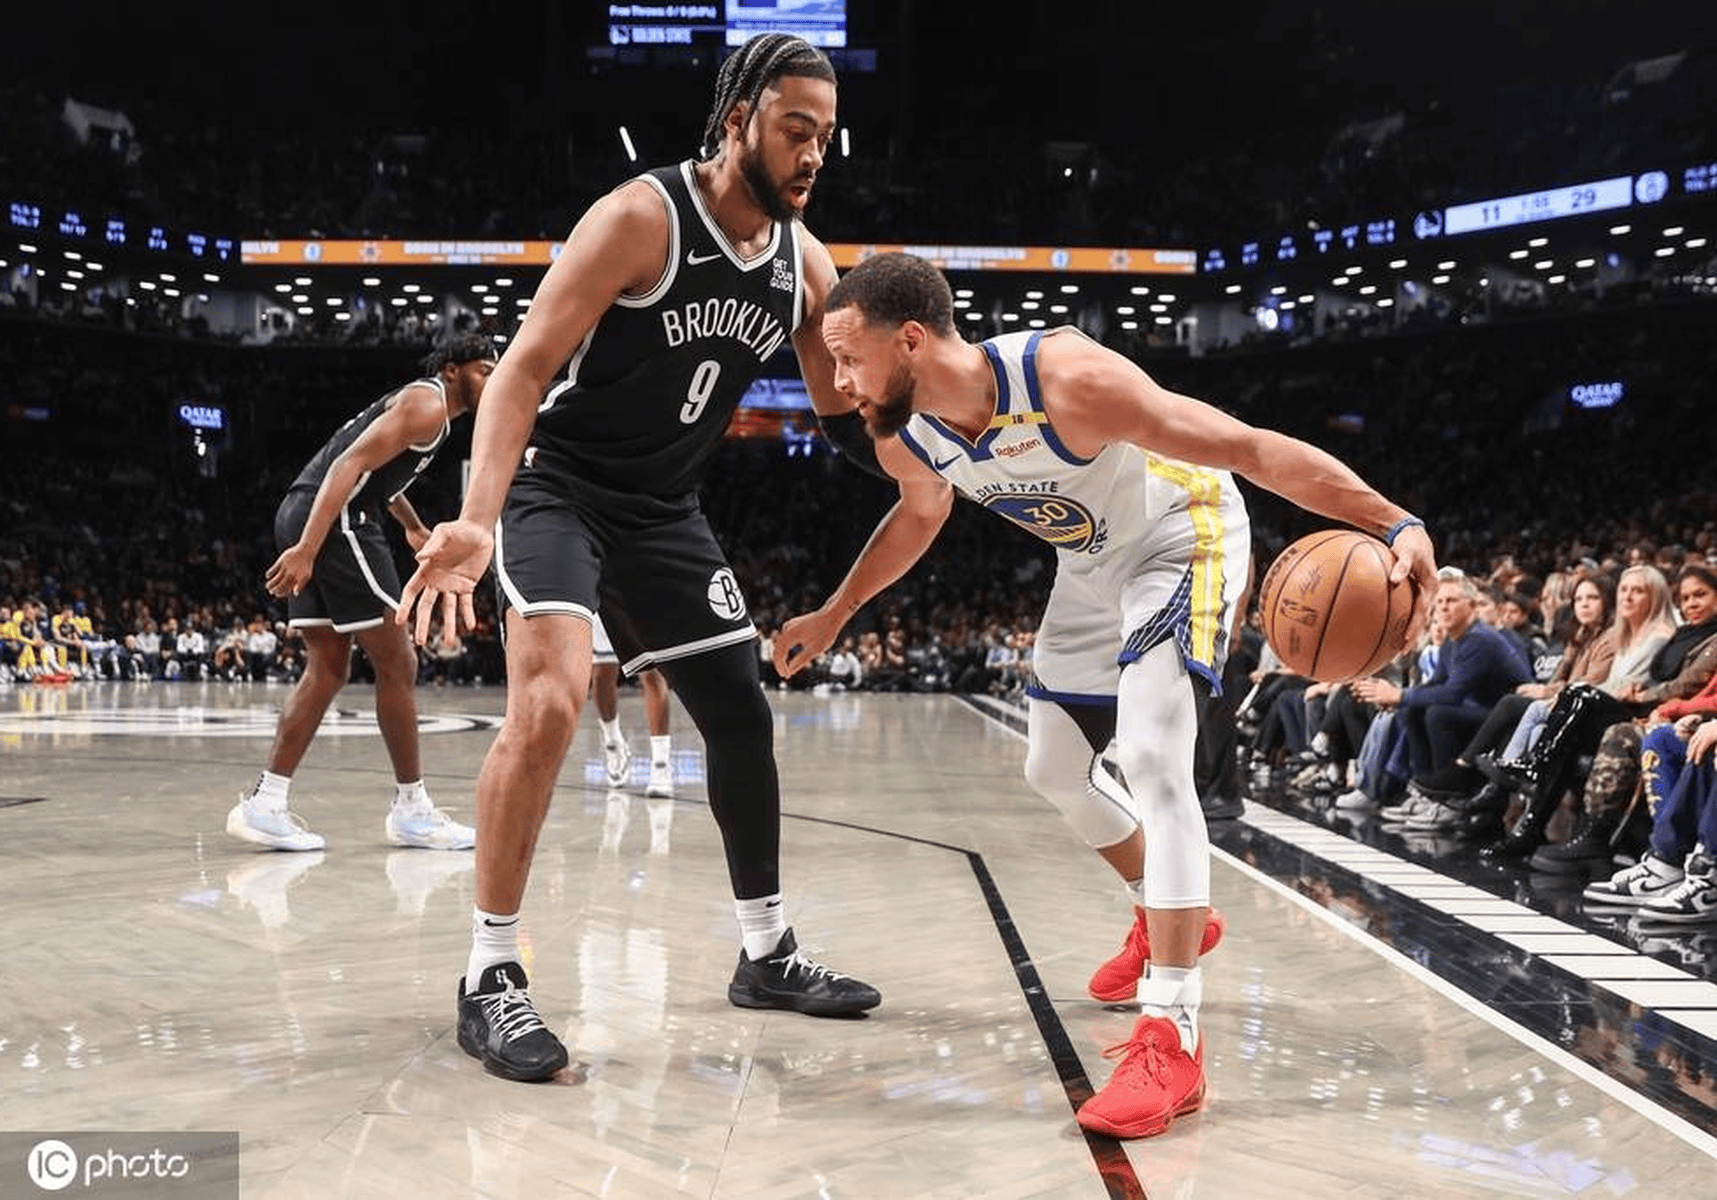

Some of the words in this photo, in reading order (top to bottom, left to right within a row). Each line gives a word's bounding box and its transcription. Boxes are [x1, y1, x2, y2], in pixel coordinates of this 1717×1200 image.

[1482, 204, 1501, 224] 11
[1571, 188, 1597, 210] 29
[772, 257, 788, 272] GET
[773, 267, 794, 283] YOUR
[662, 298, 786, 363] BROOKLYN
[679, 360, 721, 424] 9
[995, 437, 1041, 458] Rakuten
[975, 481, 1003, 501] DEN
[1009, 481, 1059, 493] STATE
[1023, 501, 1068, 526] 30
